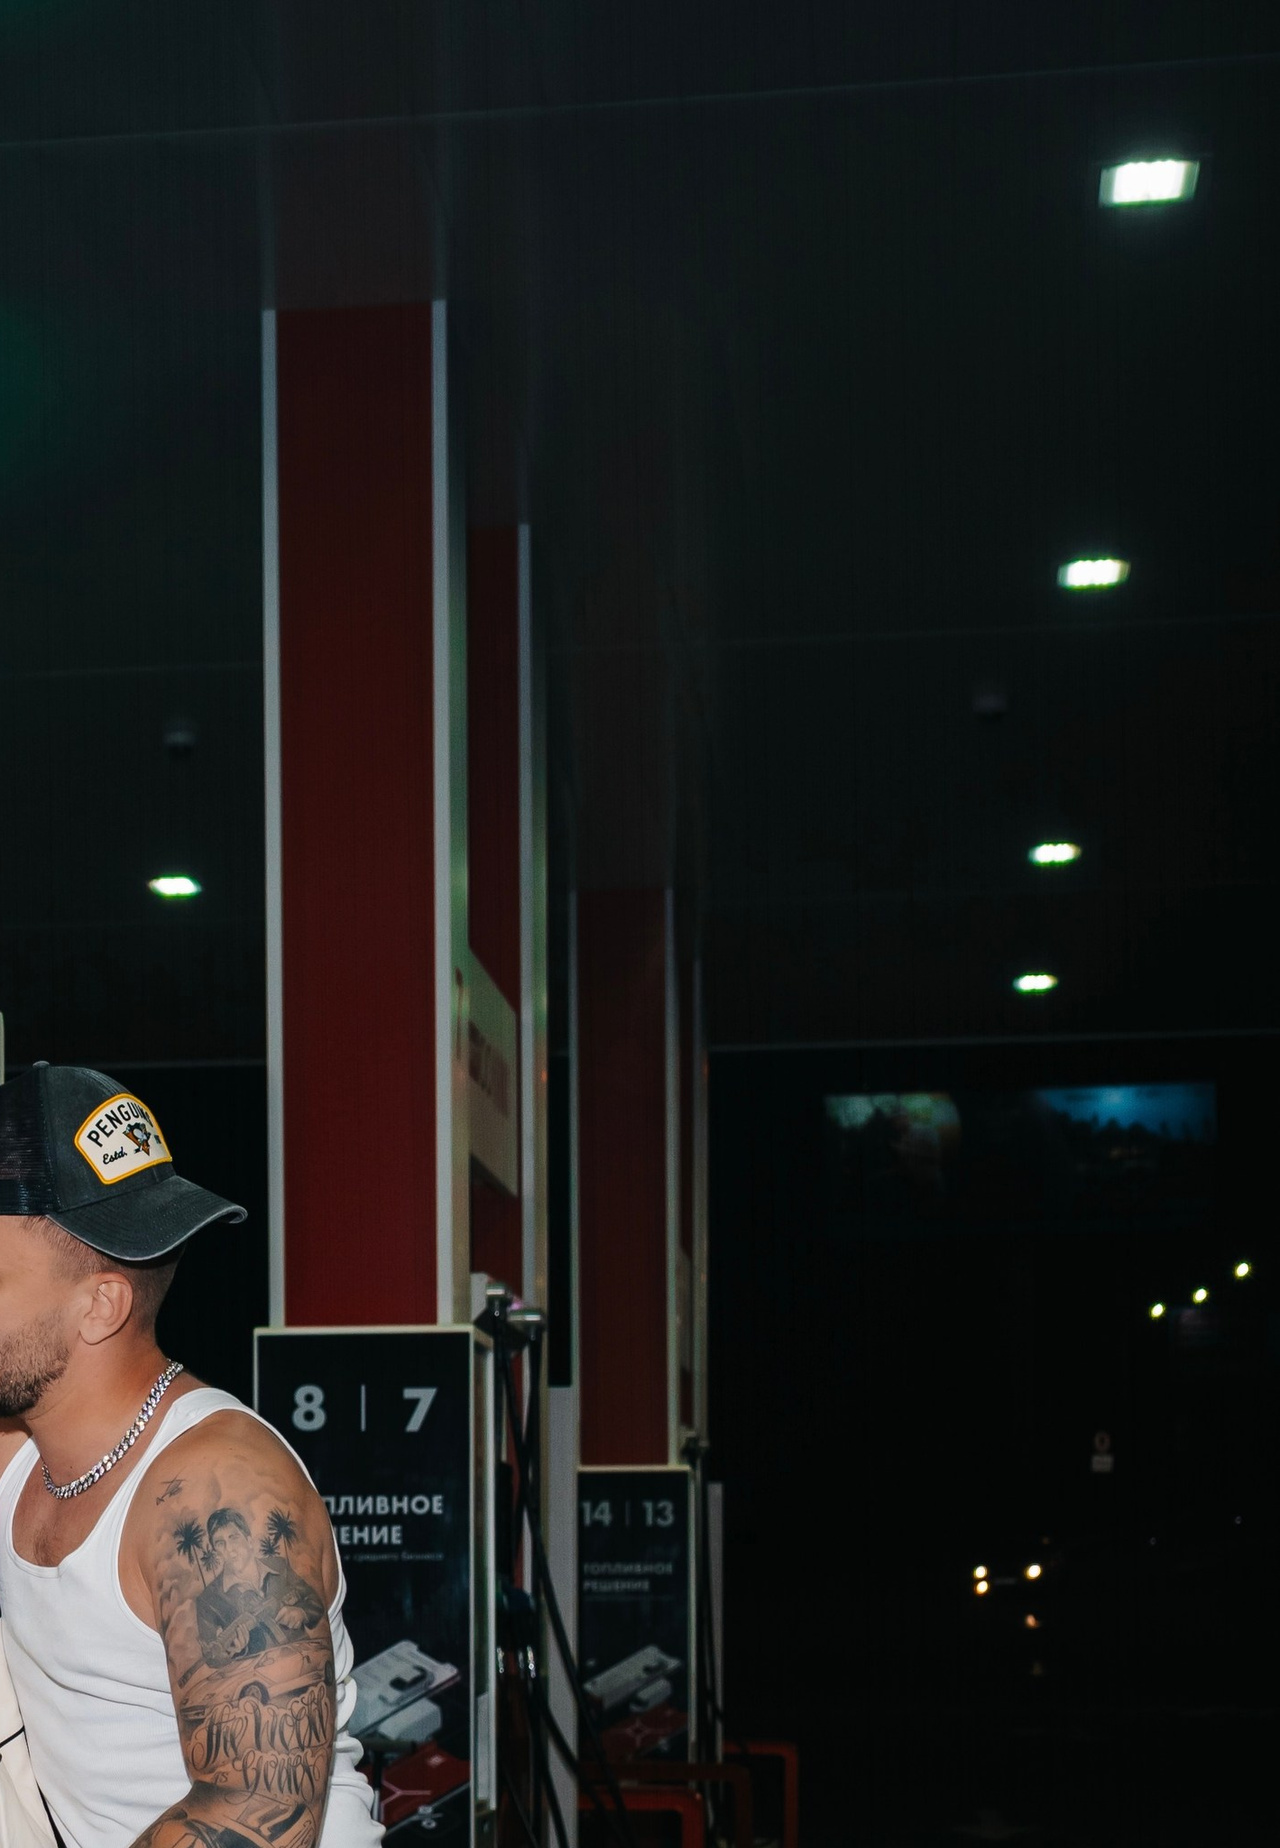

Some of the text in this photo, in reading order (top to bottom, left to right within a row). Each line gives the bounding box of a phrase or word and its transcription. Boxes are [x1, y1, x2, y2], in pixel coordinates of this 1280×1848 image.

[291, 1384, 438, 1433] 8 7
[322, 1495, 444, 1515] ПЛИВНОЕ
[582, 1501, 675, 1527] 14 13
[334, 1525, 402, 1545] ЕНИЕ
